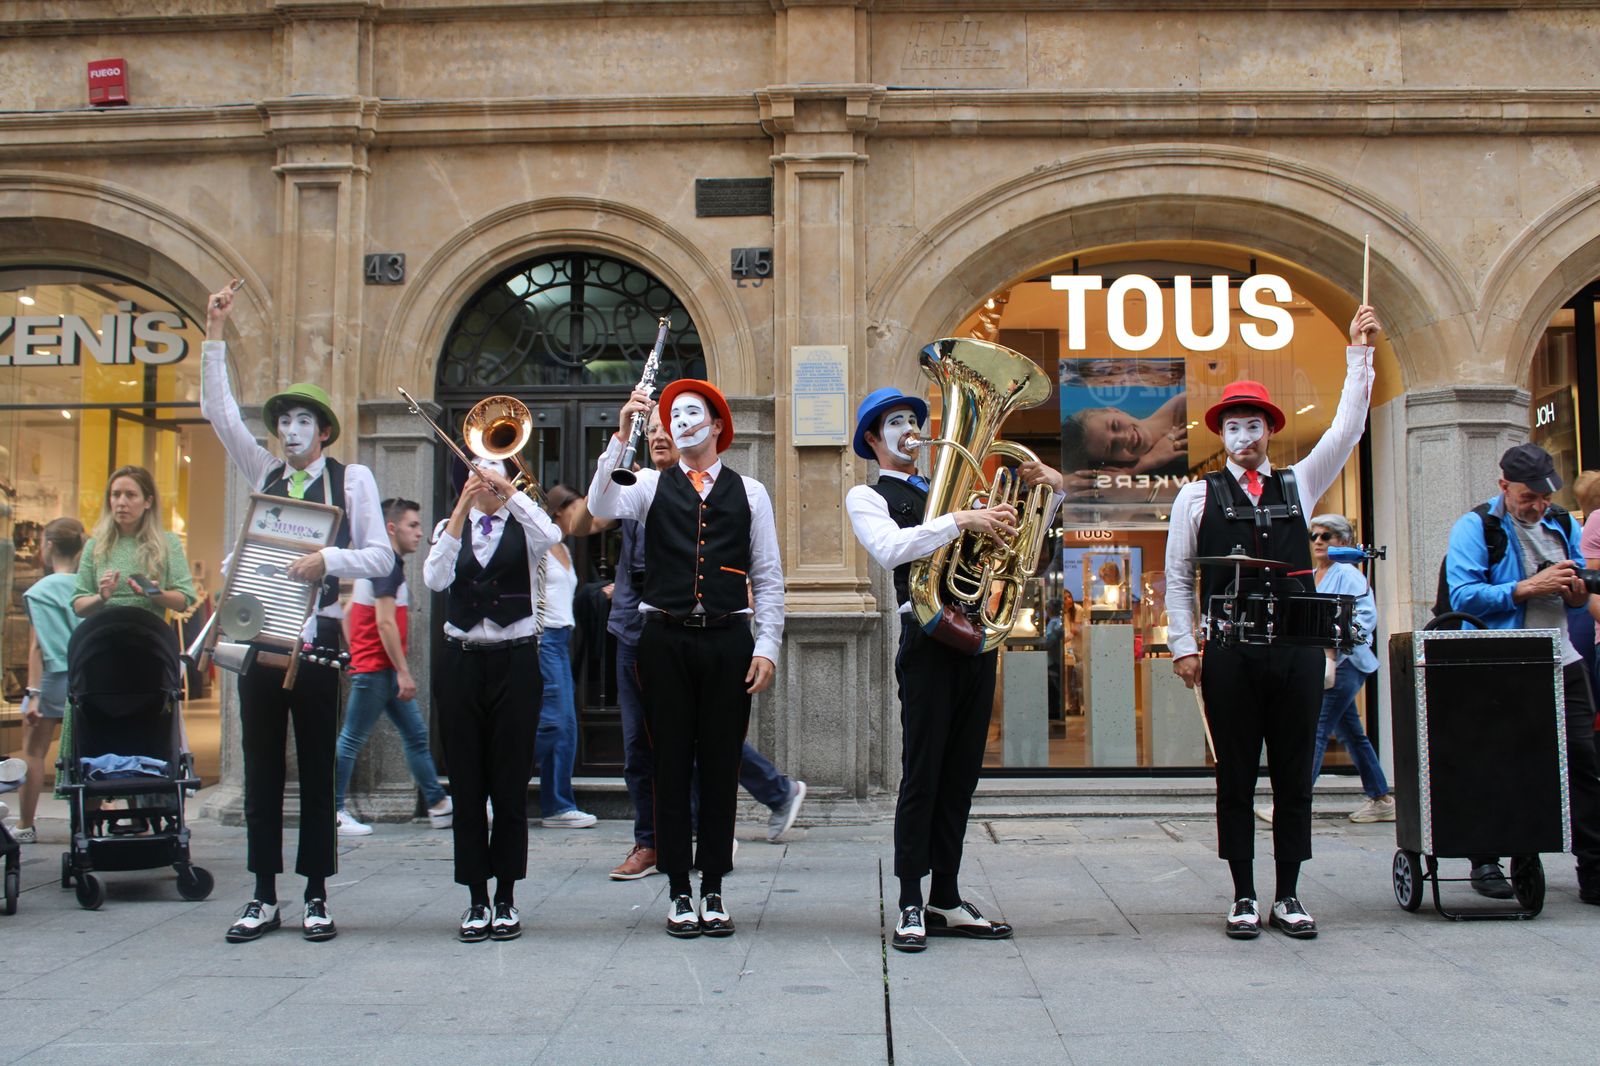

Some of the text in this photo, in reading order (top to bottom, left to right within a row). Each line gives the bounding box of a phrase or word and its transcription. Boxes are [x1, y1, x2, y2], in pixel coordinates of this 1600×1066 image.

[90, 67, 121, 79] FUEGO
[367, 254, 403, 281] 43
[733, 249, 771, 276] 45
[1050, 274, 1295, 352] TOUS
[1535, 402, 1555, 428] JOH
